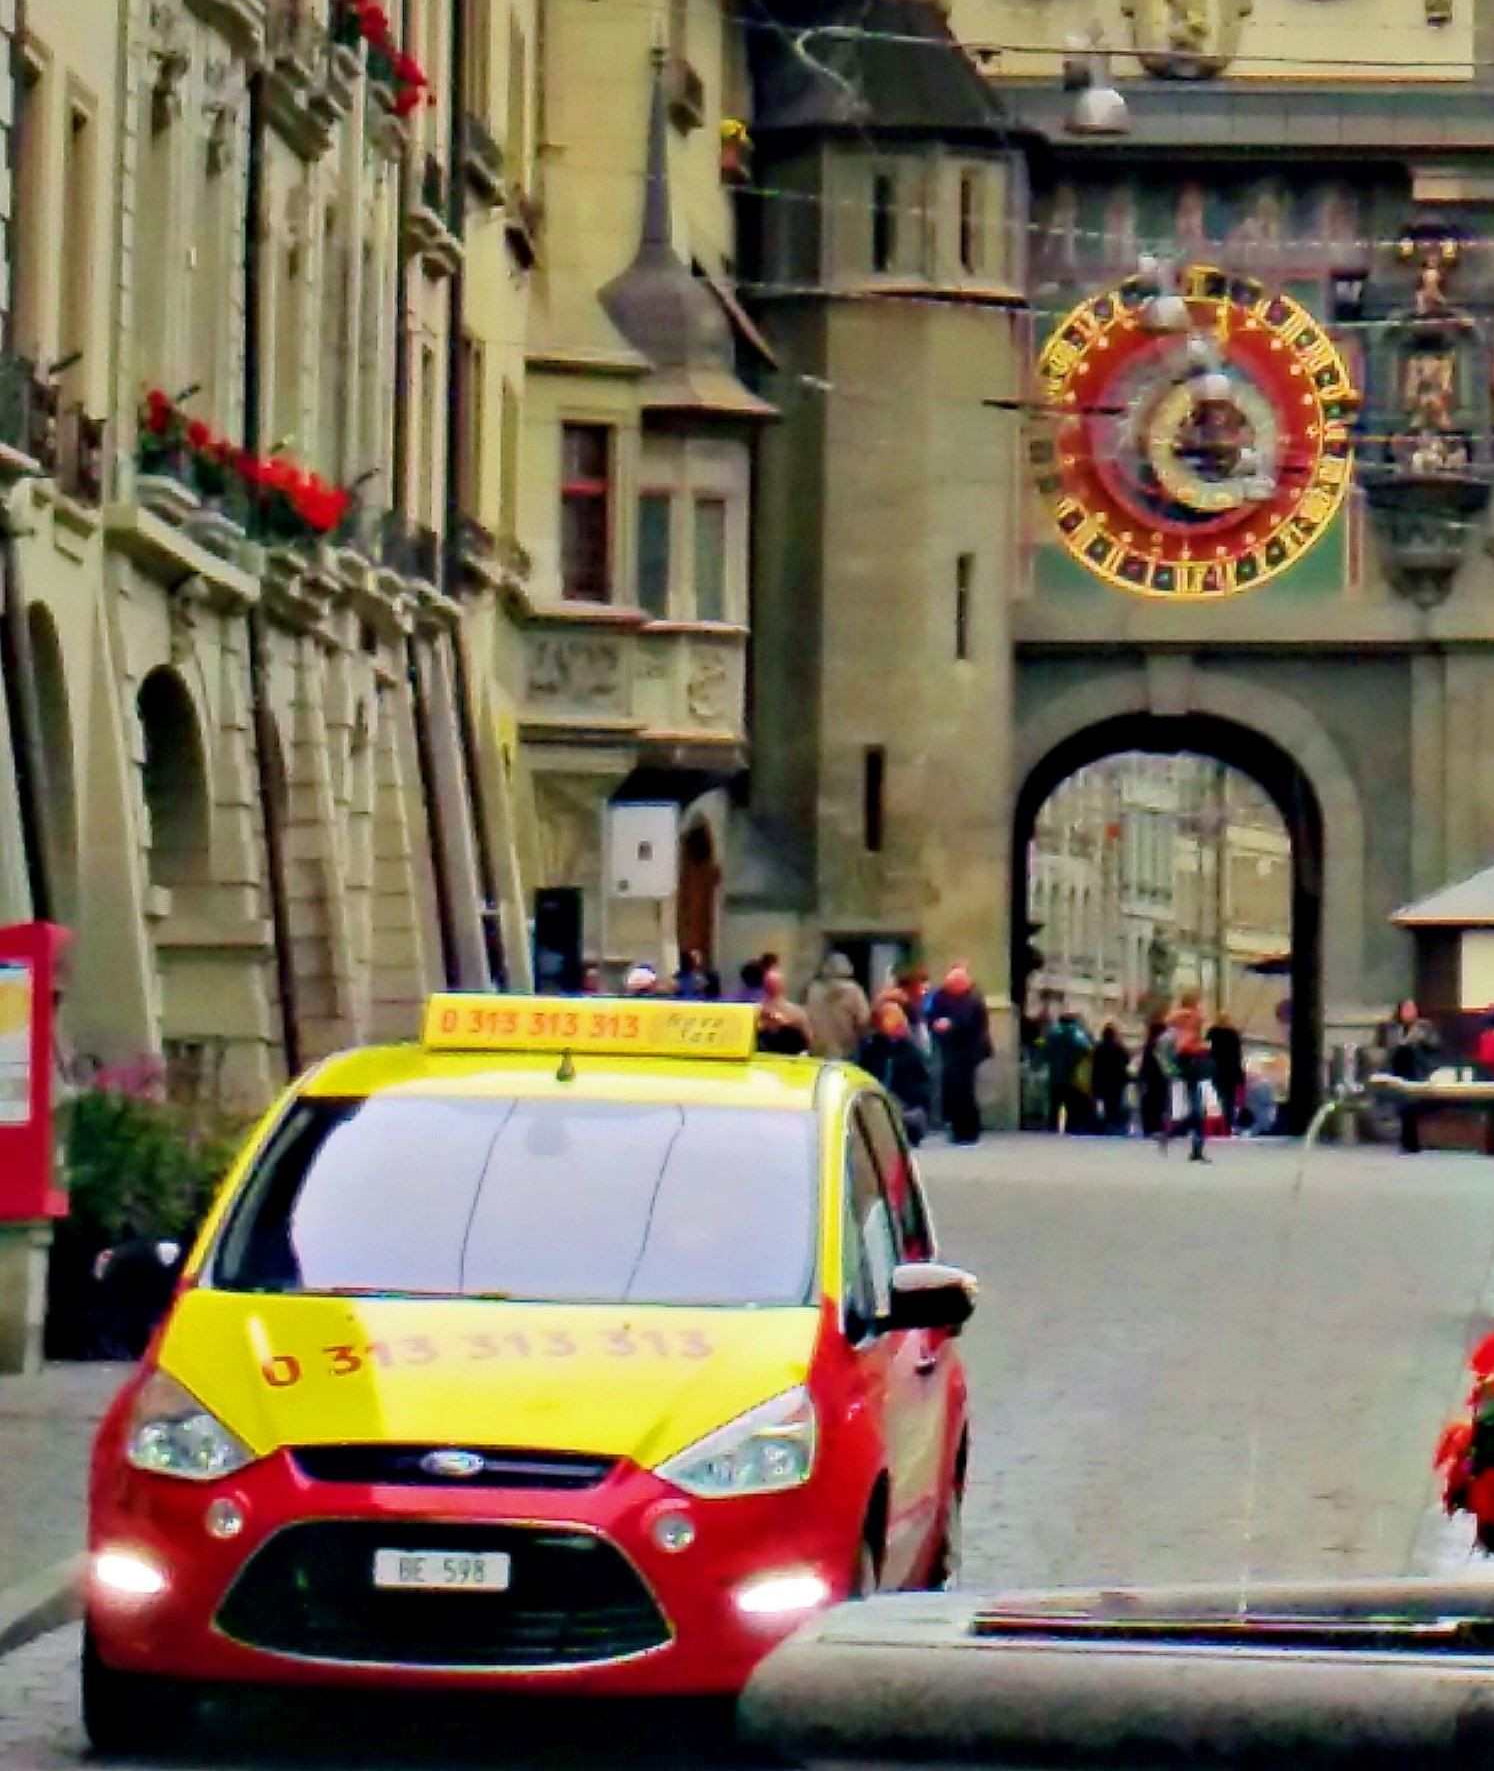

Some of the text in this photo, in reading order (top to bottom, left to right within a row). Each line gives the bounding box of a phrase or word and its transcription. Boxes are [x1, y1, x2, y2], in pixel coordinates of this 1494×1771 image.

[440, 1010, 457, 1033] 0
[468, 1011, 517, 1034] 313
[528, 1012, 579, 1036] 313
[588, 1015, 640, 1038] 313
[262, 1329, 714, 1386] 0 313 313 313
